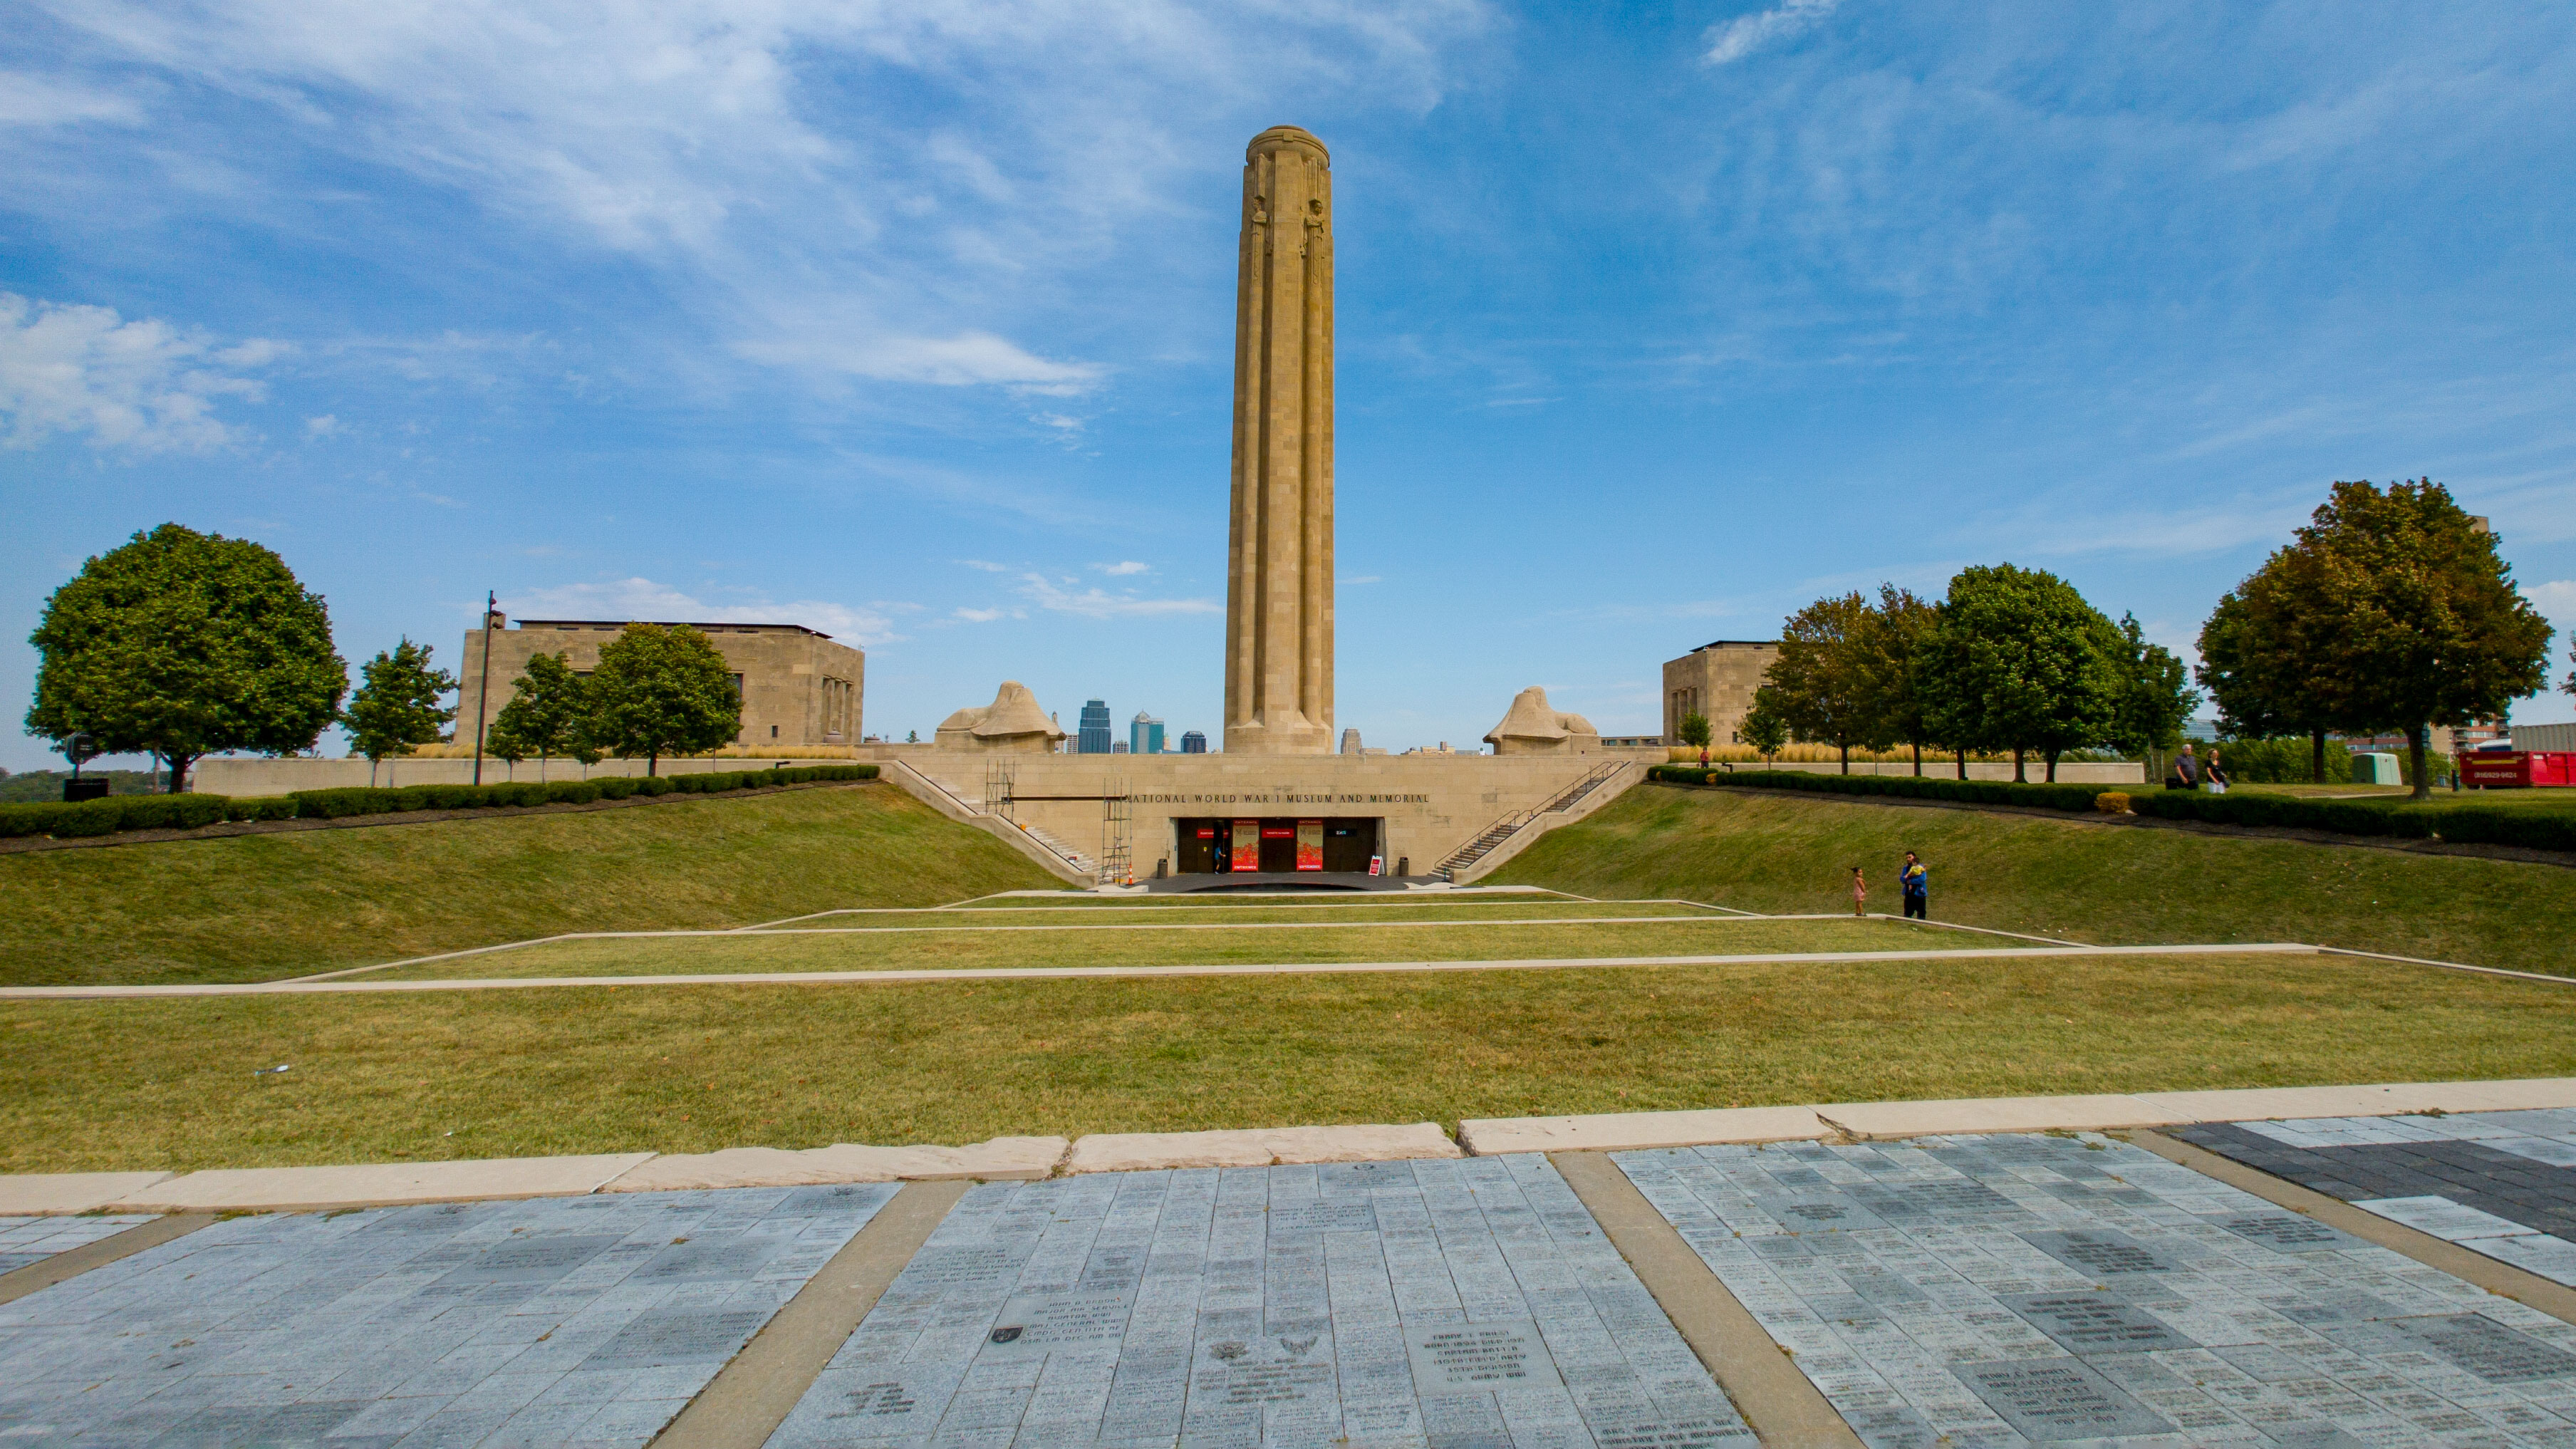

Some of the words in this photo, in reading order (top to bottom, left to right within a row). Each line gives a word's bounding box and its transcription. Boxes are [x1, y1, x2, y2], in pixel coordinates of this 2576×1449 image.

[1126, 794, 1186, 804] NATIONAL
[1195, 794, 1236, 803] WORLD
[1245, 794, 1269, 803] WAR
[1287, 794, 1331, 803] MUSEUM
[1339, 794, 1363, 803] AND
[1370, 794, 1429, 803] MEMORIAL
[1477, 1362, 1520, 1371] DIVISION
